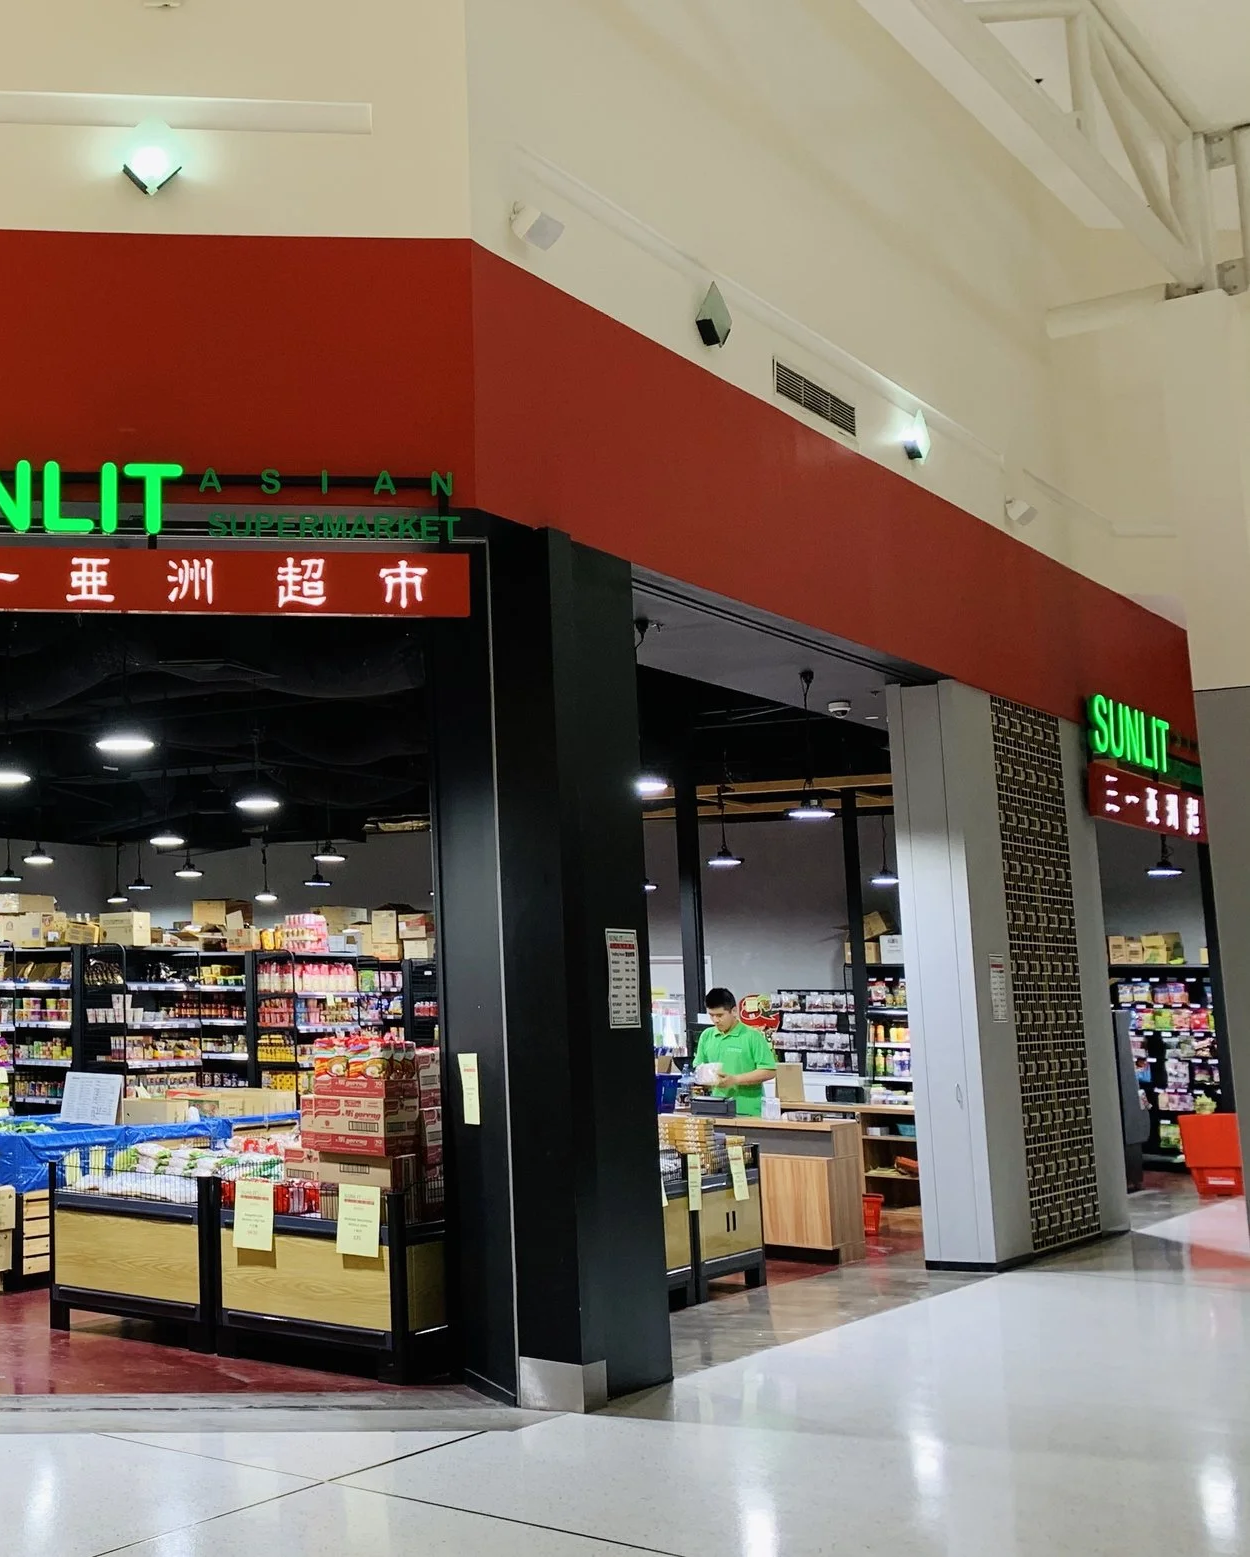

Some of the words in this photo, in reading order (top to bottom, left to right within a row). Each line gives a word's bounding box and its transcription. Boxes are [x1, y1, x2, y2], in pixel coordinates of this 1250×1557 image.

[199, 467, 453, 497] ASIAN
[207, 511, 462, 543] SUPERMARKET
[1092, 694, 1170, 773] SUNLIT
